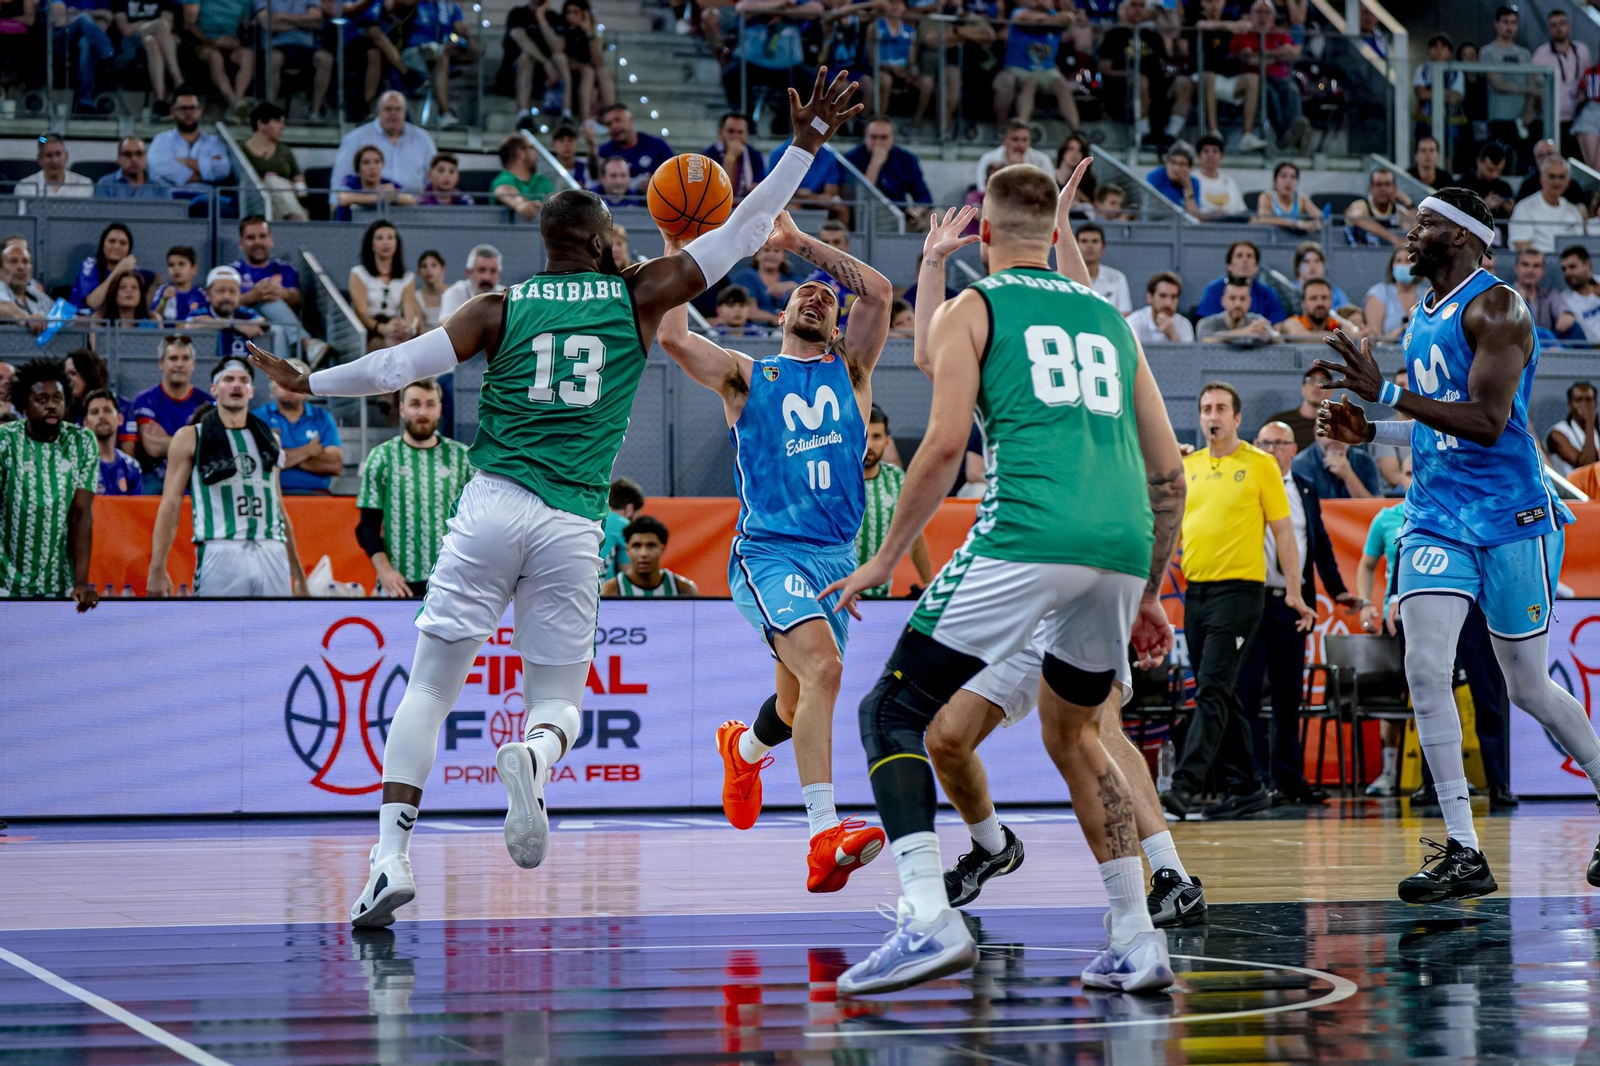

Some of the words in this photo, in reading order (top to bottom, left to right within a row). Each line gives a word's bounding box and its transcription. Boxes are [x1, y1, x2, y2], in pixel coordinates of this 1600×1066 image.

[510, 280, 622, 302] KASIBABU
[527, 332, 607, 408] 13
[1023, 324, 1123, 419] 88
[785, 429, 843, 458] Estudiantes
[806, 460, 832, 490] 10
[236, 496, 263, 517] 22
[1412, 546, 1449, 575] hp
[586, 764, 640, 782] FEB
